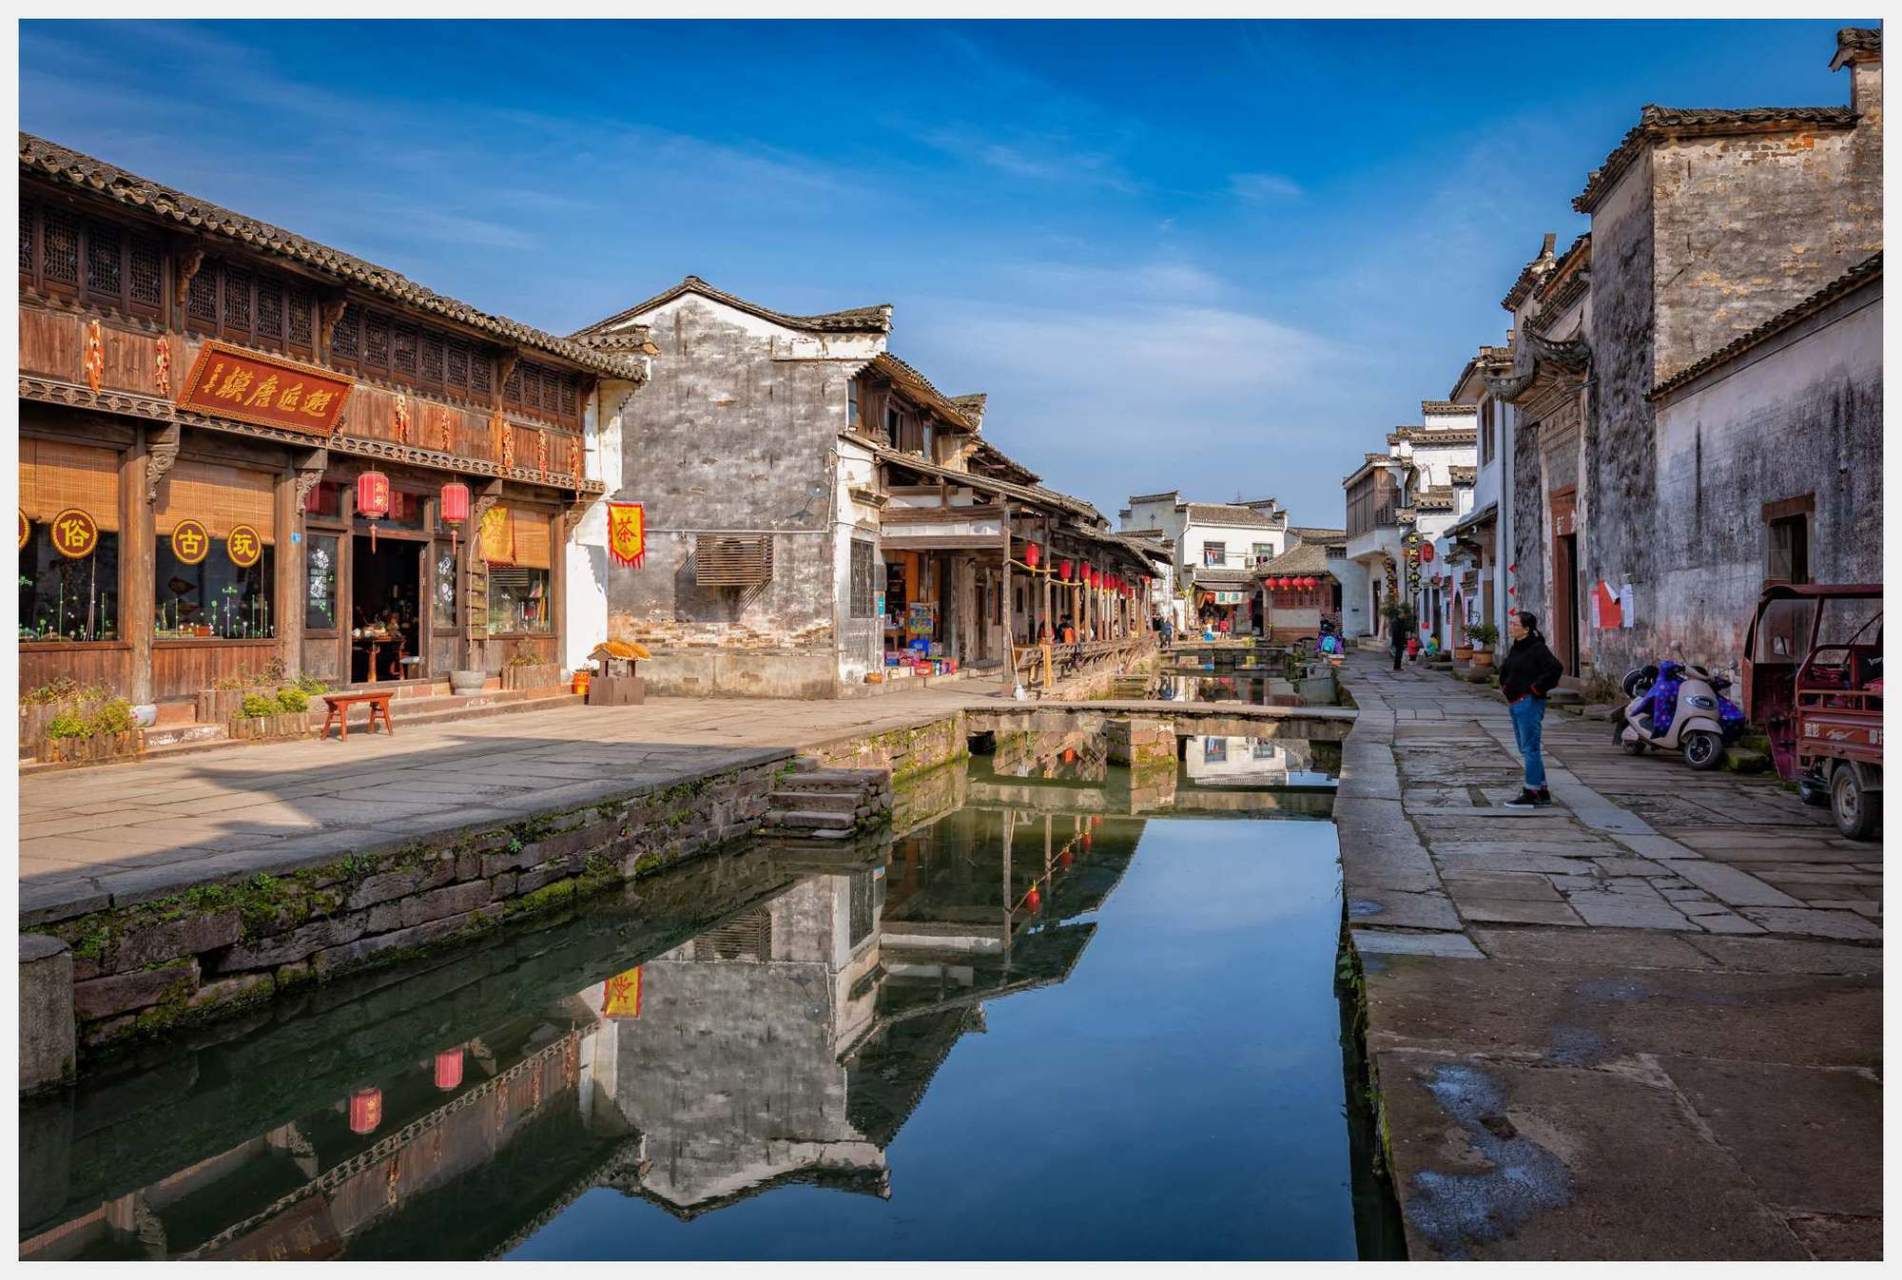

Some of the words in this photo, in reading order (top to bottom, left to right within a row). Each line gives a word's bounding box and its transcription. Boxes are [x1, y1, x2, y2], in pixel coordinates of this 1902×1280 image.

[60, 519, 90, 548] 俗
[178, 529, 255, 558] 古玩
[617, 516, 637, 543] 茶
